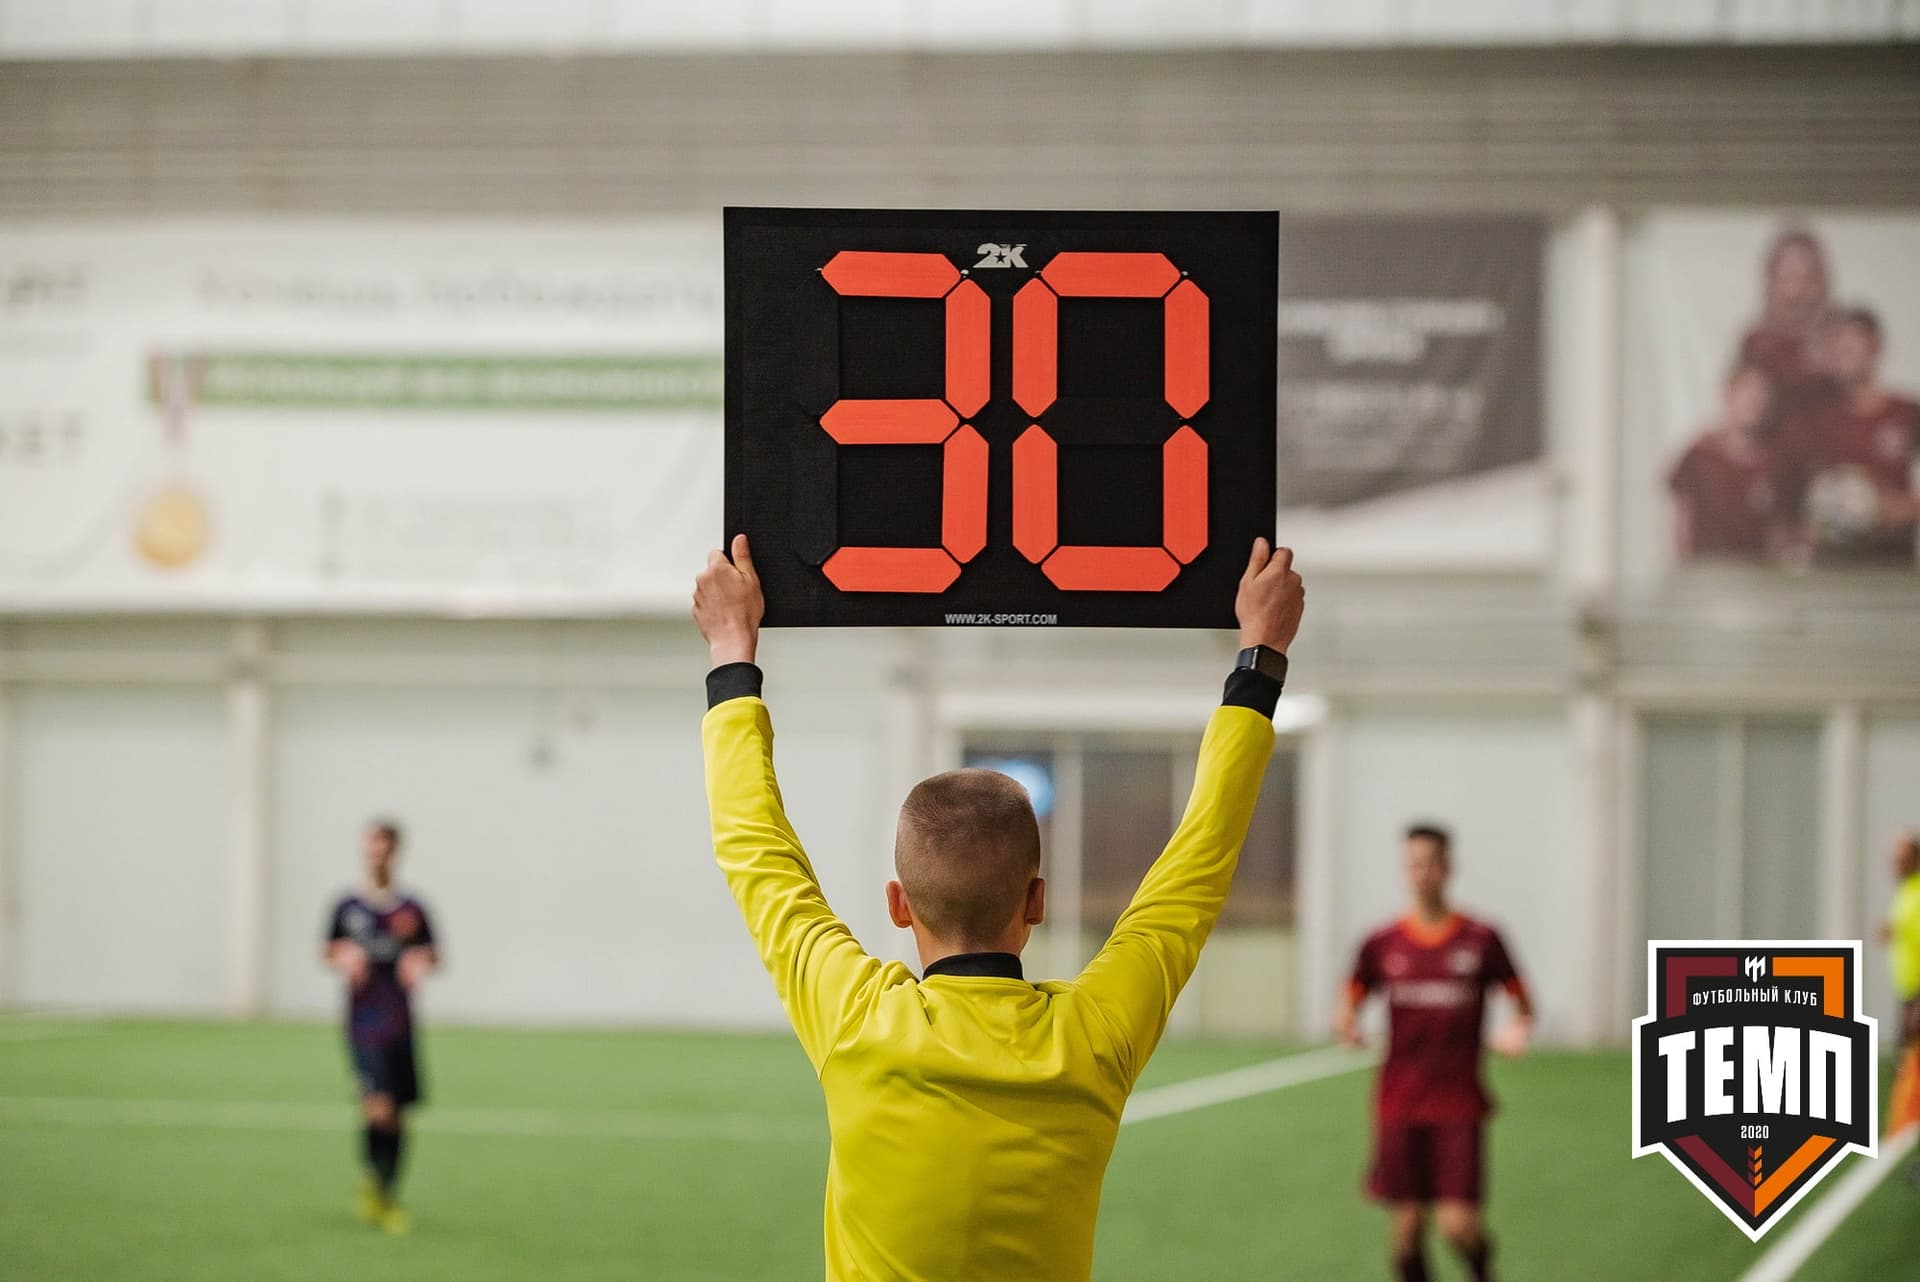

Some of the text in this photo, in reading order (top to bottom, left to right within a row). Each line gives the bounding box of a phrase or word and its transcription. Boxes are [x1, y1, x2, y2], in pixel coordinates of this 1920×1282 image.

[973, 243, 1029, 268] 2K
[819, 251, 1210, 593] 30
[945, 614, 1057, 625] WWW.2K-SPORT.COM
